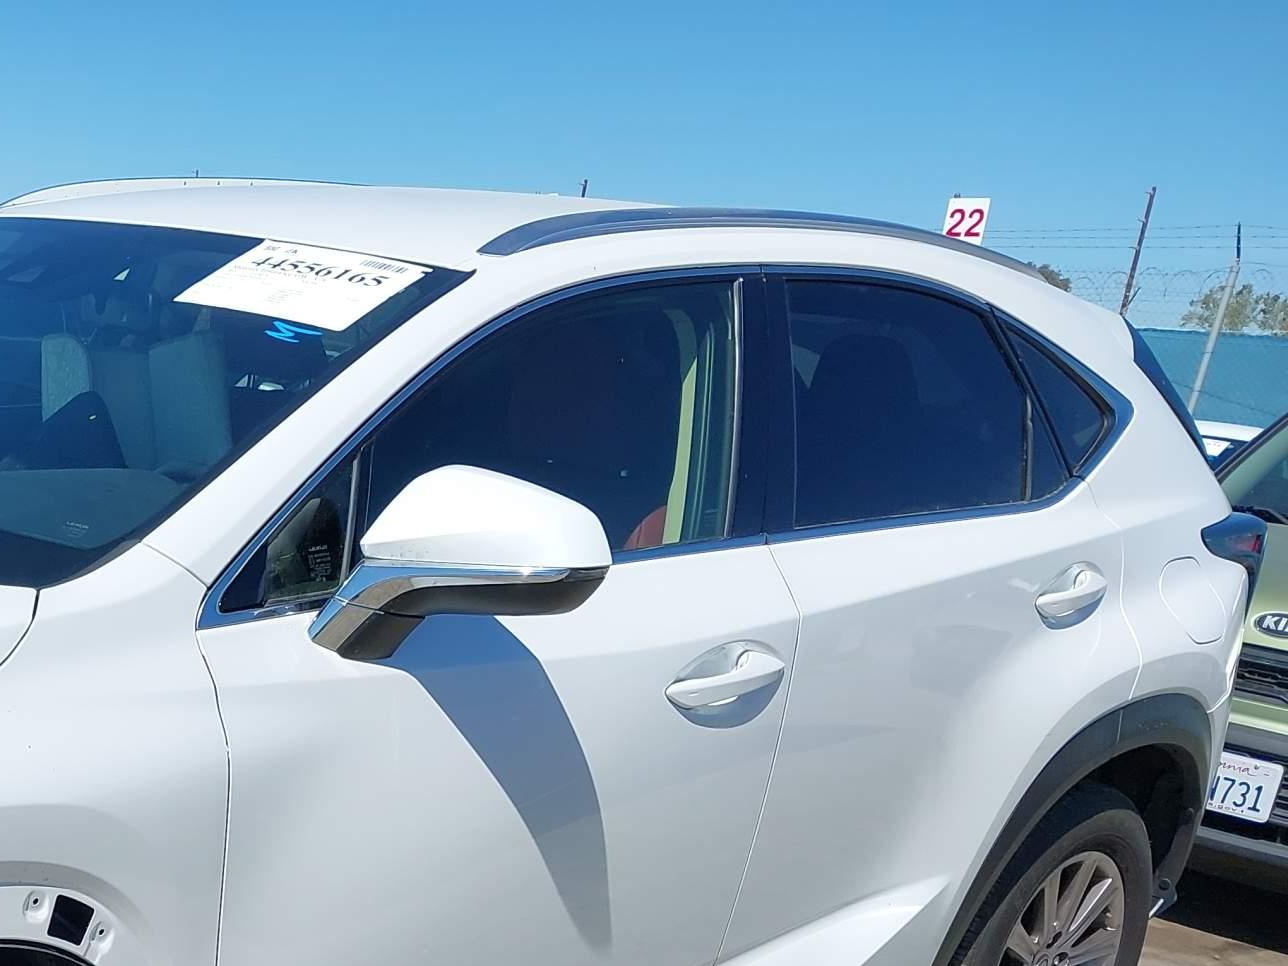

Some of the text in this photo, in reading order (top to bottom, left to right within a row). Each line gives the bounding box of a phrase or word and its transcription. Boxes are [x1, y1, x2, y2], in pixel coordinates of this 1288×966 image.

[945, 208, 985, 238] 22
[251, 256, 391, 287] 44556165
[1262, 615, 1288, 633] KI
